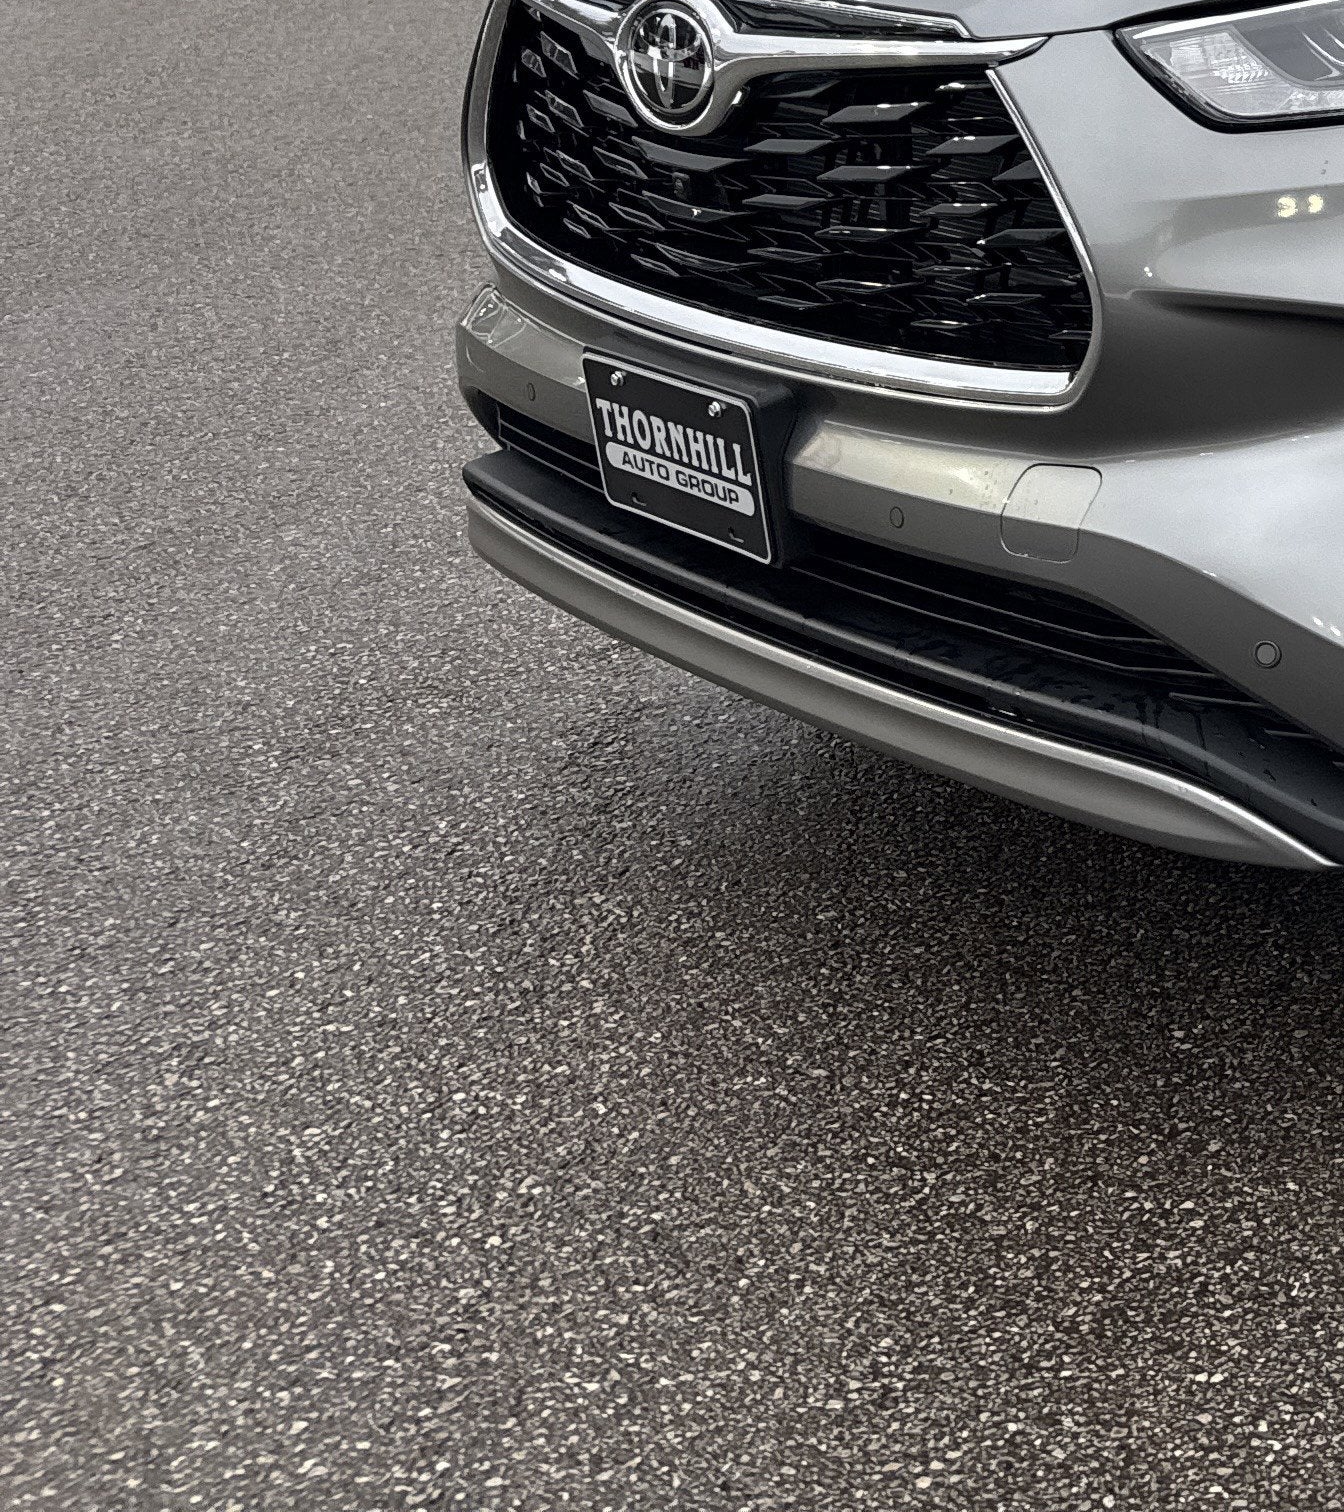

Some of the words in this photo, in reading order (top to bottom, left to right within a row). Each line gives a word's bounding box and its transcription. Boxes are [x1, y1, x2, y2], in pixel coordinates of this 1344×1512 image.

[595, 398, 753, 486] THORNHILL
[621, 451, 671, 481] AUTO
[676, 470, 740, 505] GROUP
